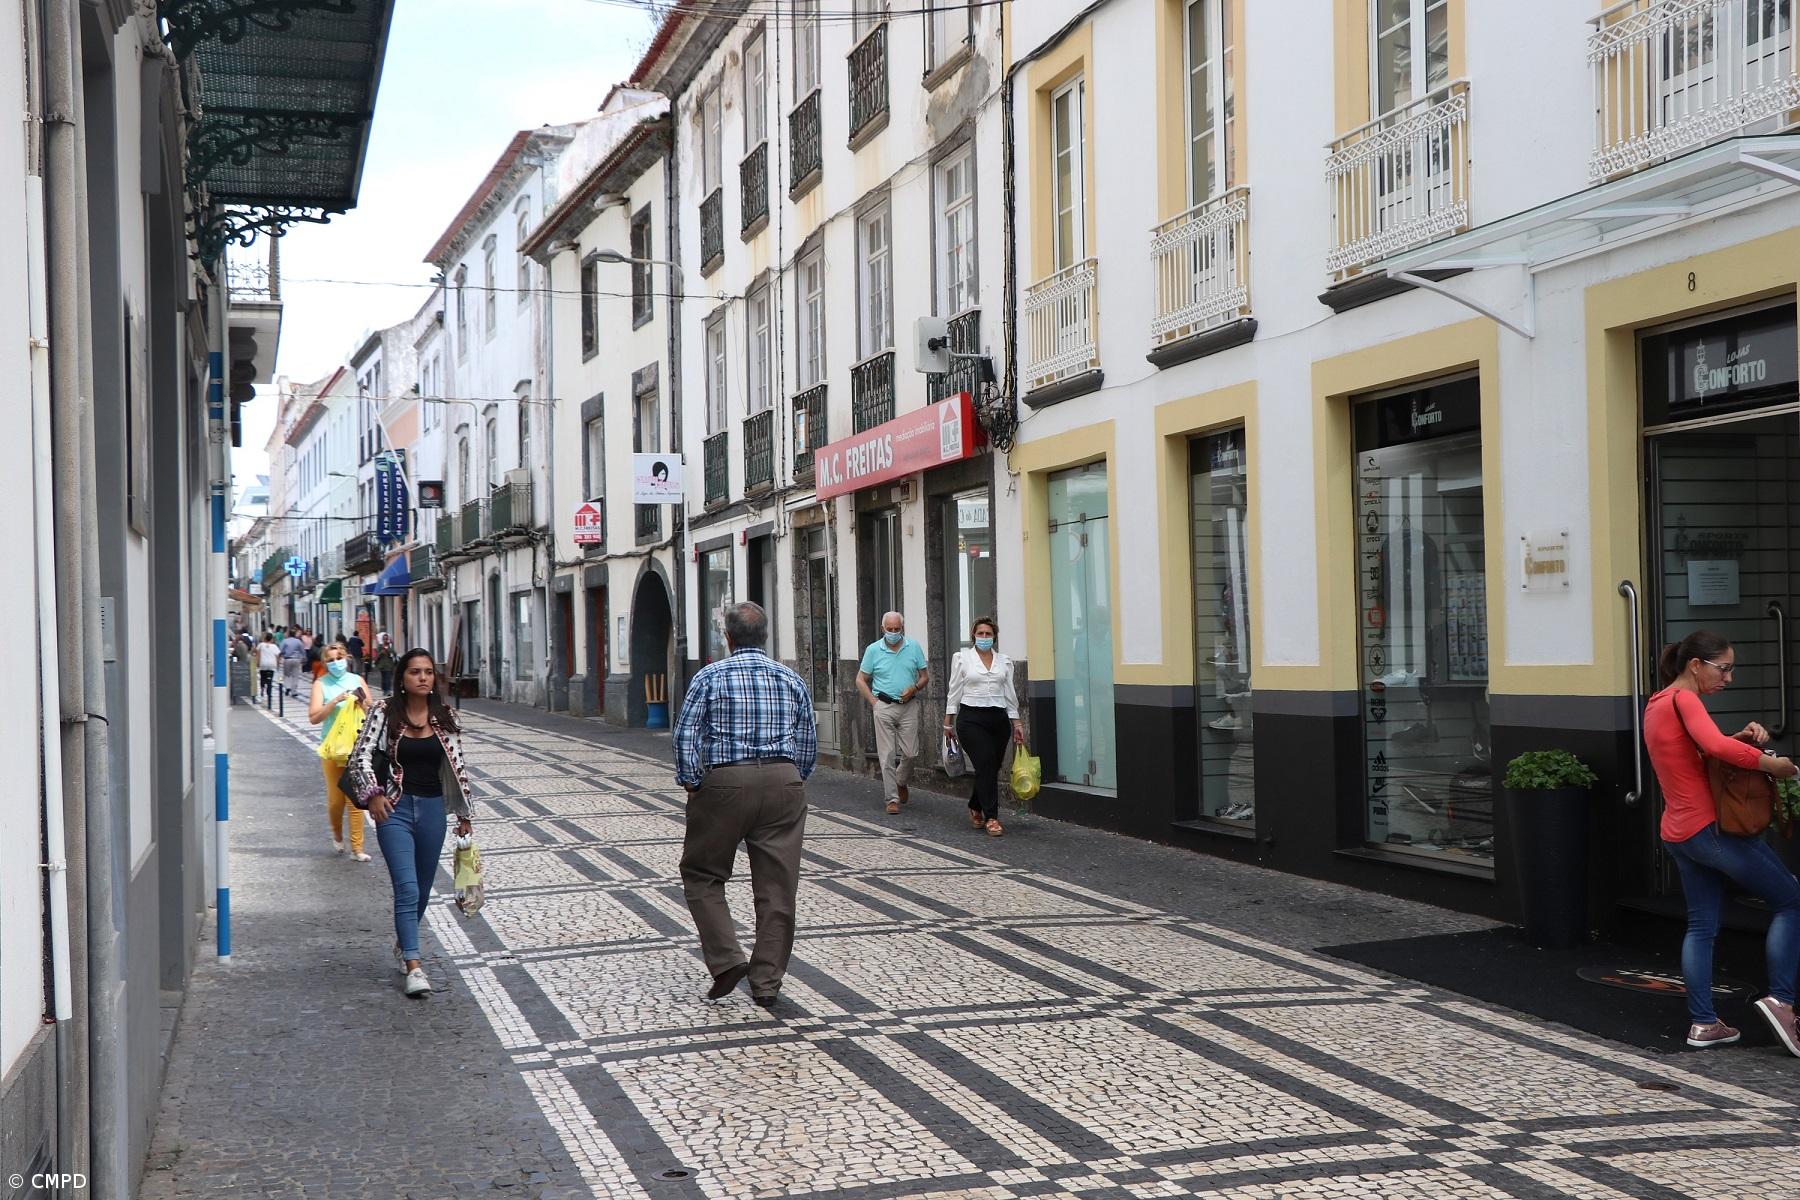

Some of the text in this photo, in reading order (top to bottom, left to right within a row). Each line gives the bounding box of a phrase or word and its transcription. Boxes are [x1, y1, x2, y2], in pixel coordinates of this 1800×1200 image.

[1688, 271, 1696, 291] 8
[1726, 344, 1751, 363] LOJAS
[1694, 359, 1766, 393] CONFORTO
[820, 434, 894, 488] M.C. FREITAS
